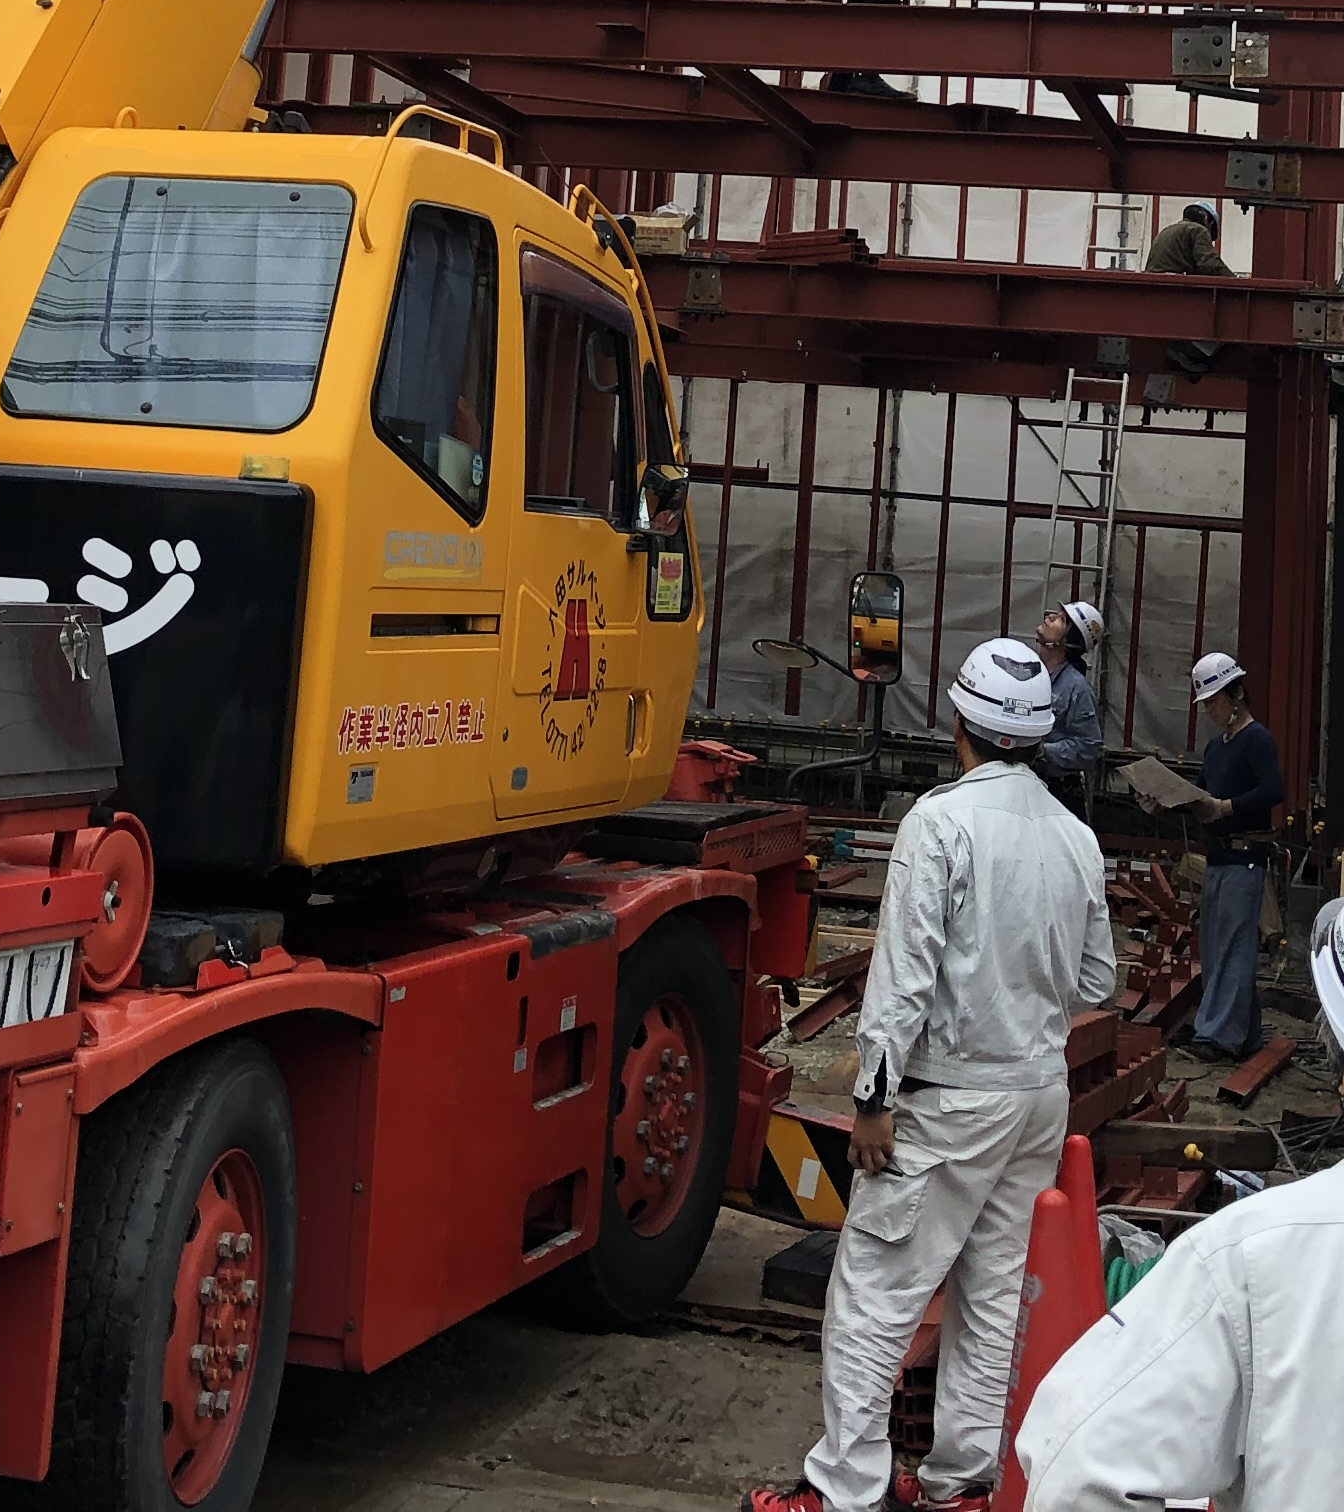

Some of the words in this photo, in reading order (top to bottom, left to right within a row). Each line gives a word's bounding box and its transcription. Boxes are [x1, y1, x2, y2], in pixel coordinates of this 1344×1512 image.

[338, 697, 485, 755] 作業半径内立入禁止
